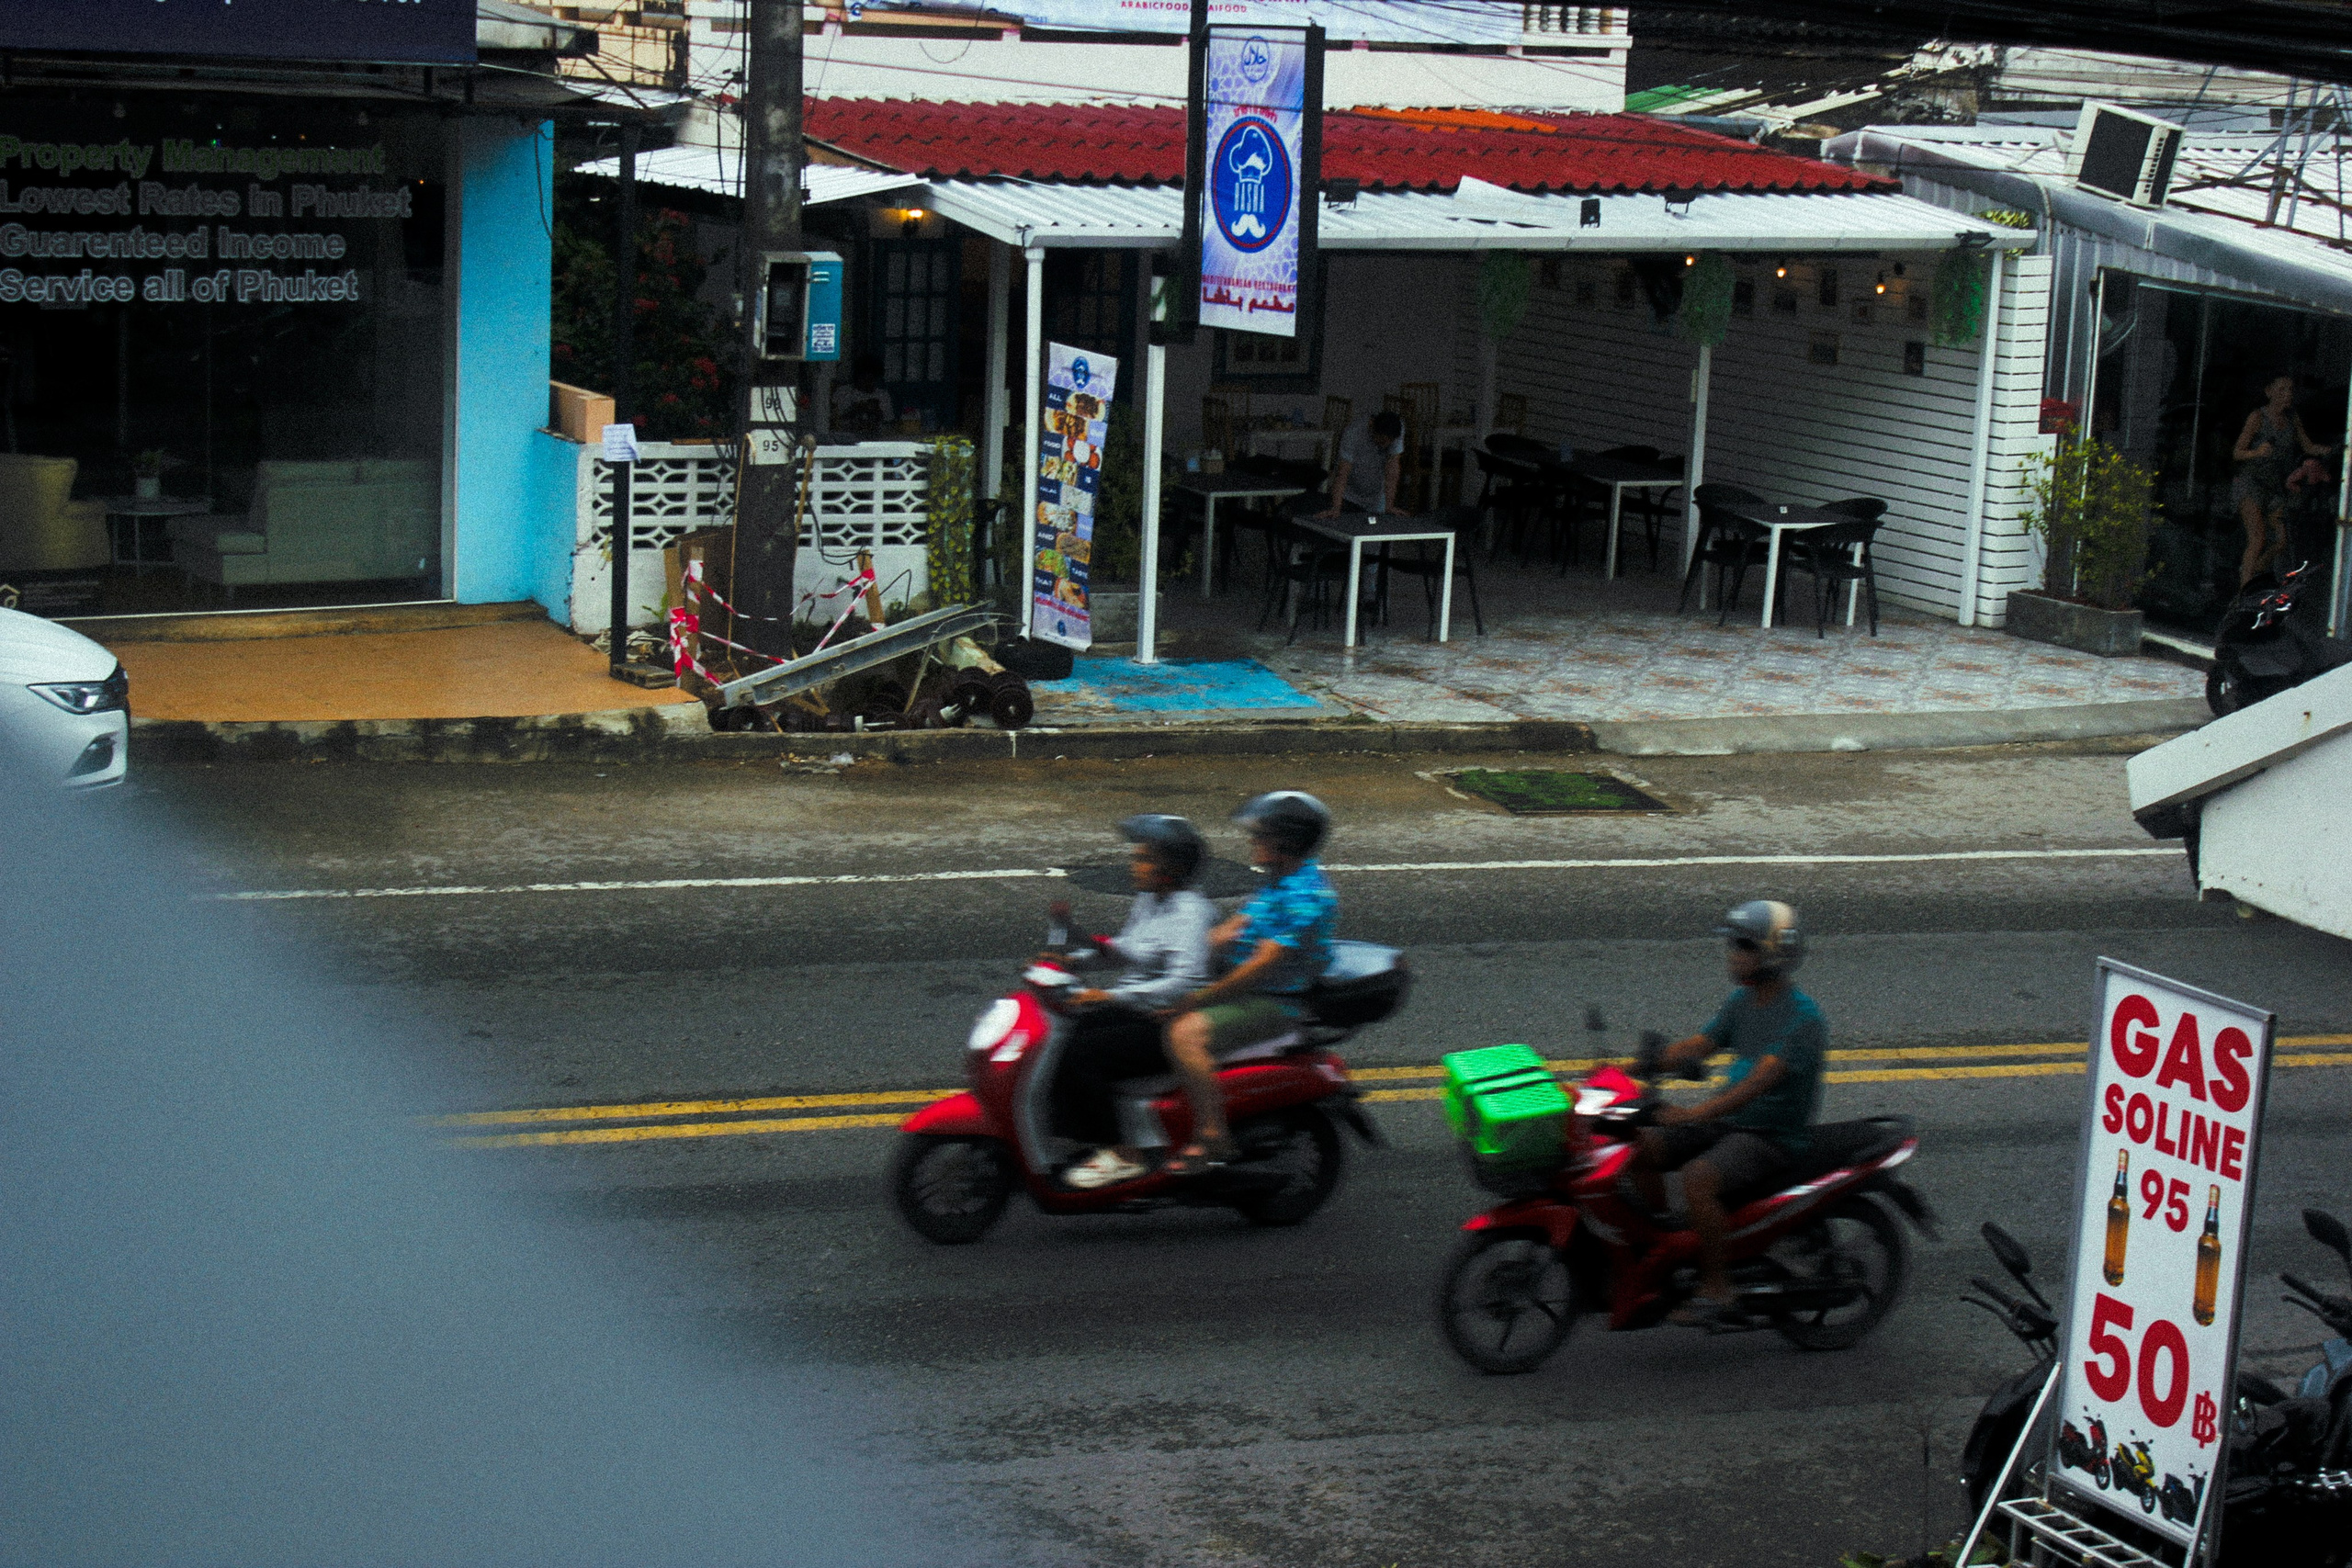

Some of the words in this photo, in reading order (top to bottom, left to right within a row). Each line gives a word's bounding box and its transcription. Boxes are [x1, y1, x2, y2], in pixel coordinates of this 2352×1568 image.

[0, 134, 153, 179] Property
[163, 139, 385, 180] Management
[0, 179, 131, 216] Lowest
[139, 180, 241, 217] Rates
[291, 184, 413, 219] Phuket
[0, 223, 209, 259] Guarenteed
[218, 226, 346, 260] Income
[0, 268, 134, 302] Service
[143, 269, 185, 302] all
[192, 269, 230, 302] of
[237, 269, 358, 302] Phuket
[763, 440, 779, 452] 95
[2110, 994, 2253, 1112] GAS
[2102, 1083, 2246, 1182] SOLINE
[2141, 1168, 2190, 1233] 95
[2084, 1292, 2189, 1428] 50
